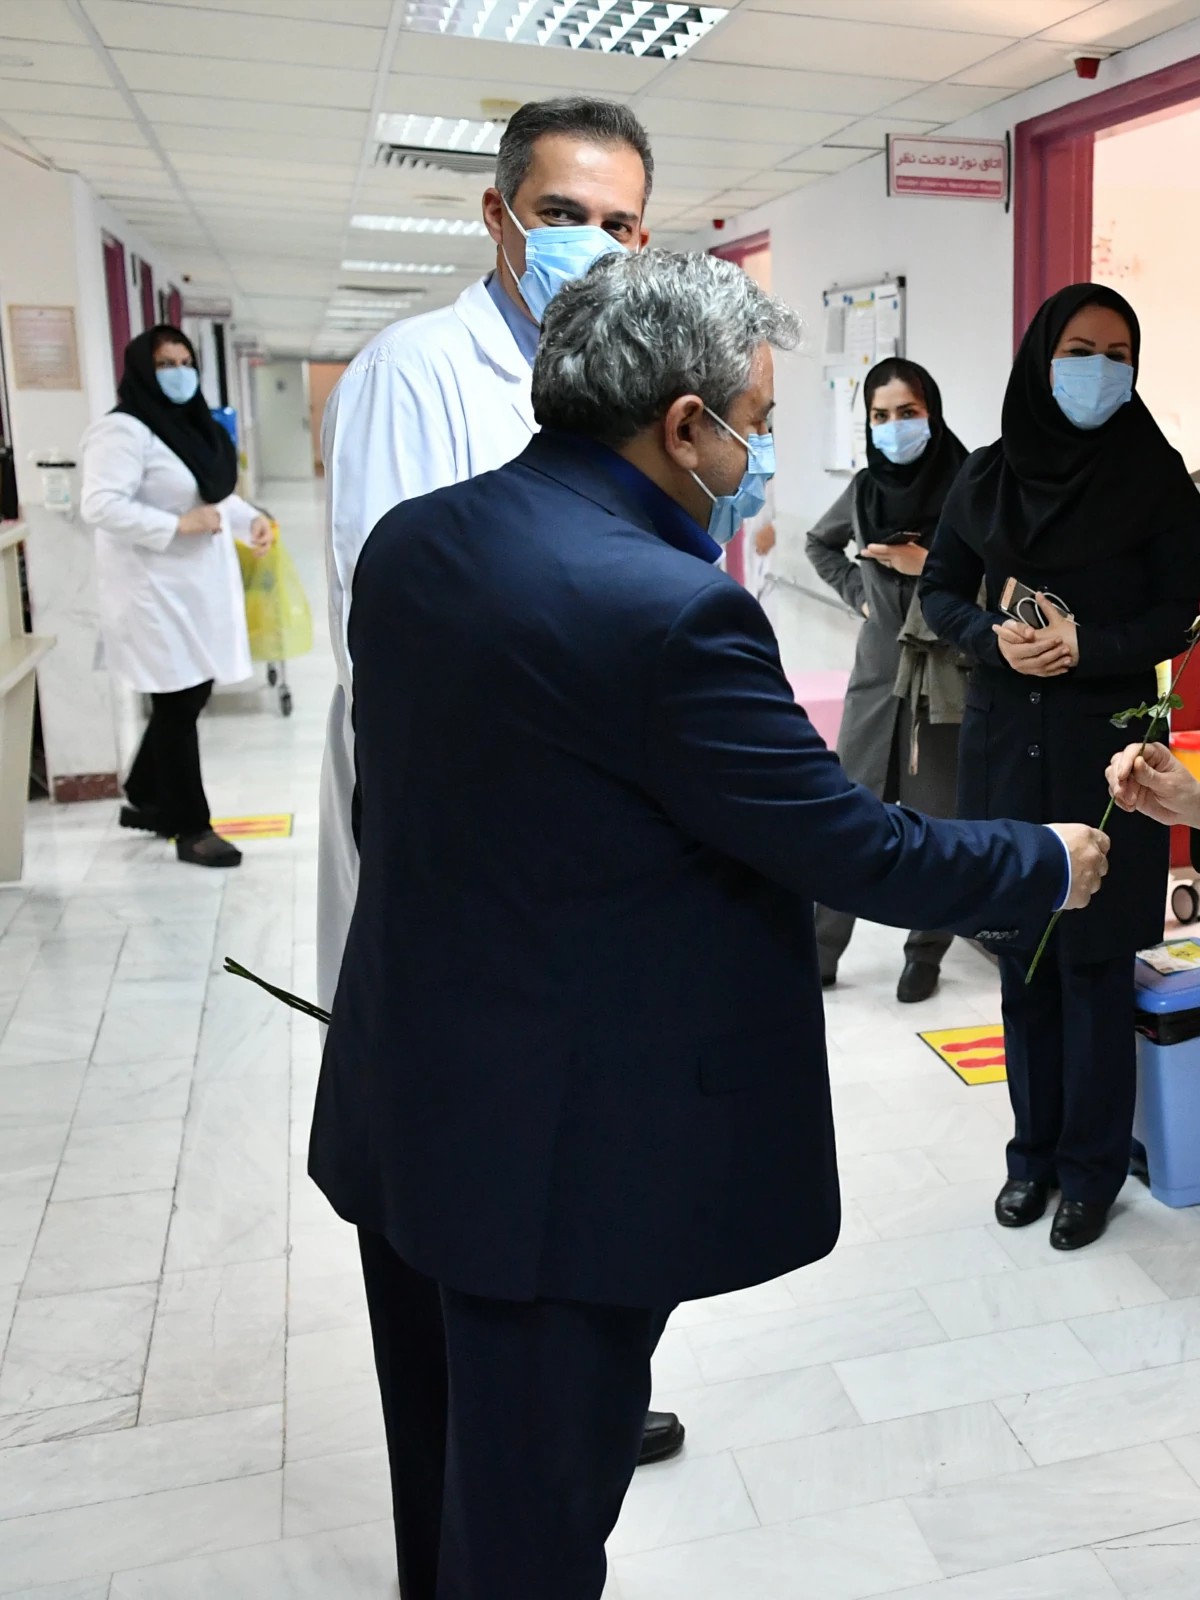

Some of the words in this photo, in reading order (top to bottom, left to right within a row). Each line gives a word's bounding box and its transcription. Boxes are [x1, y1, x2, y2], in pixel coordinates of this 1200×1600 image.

[896, 152, 916, 166] نظر
[918, 154, 946, 166] تحت
[948, 155, 977, 170] نوزاد
